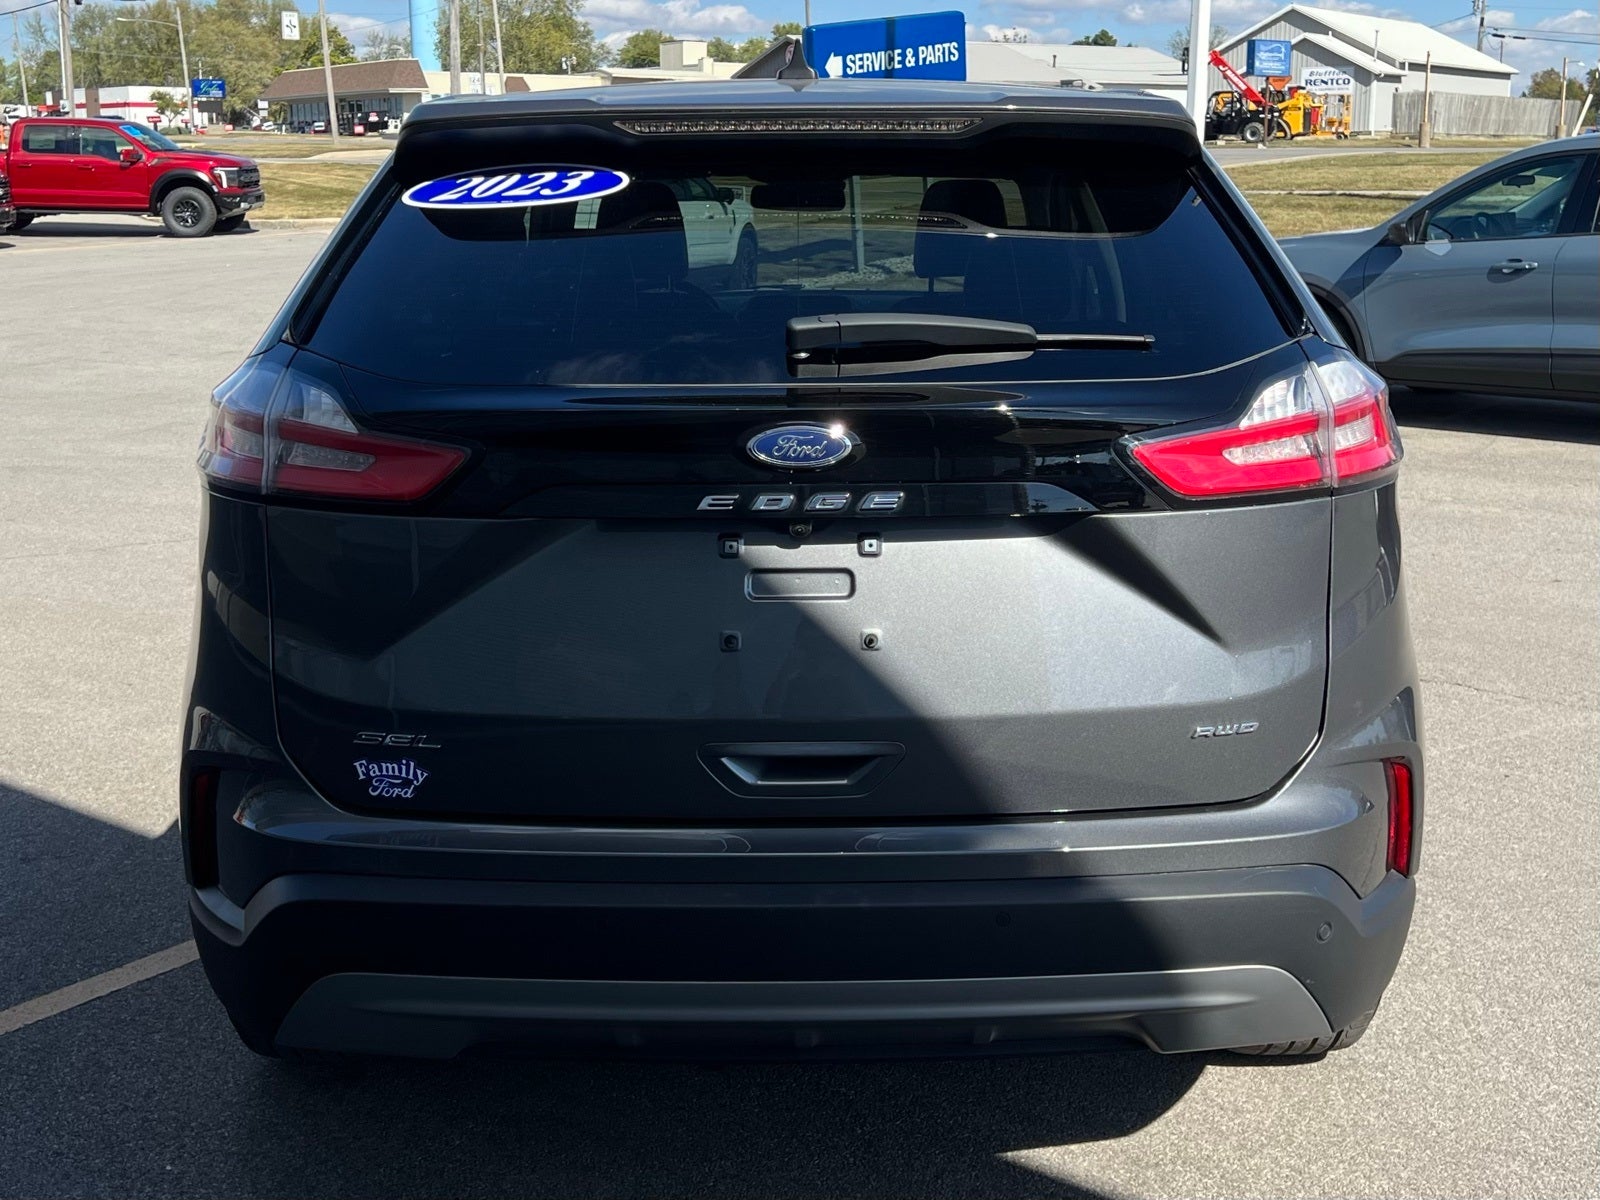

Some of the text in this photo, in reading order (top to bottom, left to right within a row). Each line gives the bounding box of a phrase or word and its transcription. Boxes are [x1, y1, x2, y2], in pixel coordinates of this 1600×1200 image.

[846, 42, 959, 75] SERVICE & PARTS
[1305, 77, 1351, 87] RENTCO
[428, 171, 595, 202] 2023
[772, 433, 828, 459] Ford
[696, 491, 905, 512] EDGE
[353, 731, 442, 748] SEL
[353, 759, 429, 786] Family
[368, 776, 416, 798] Ford
